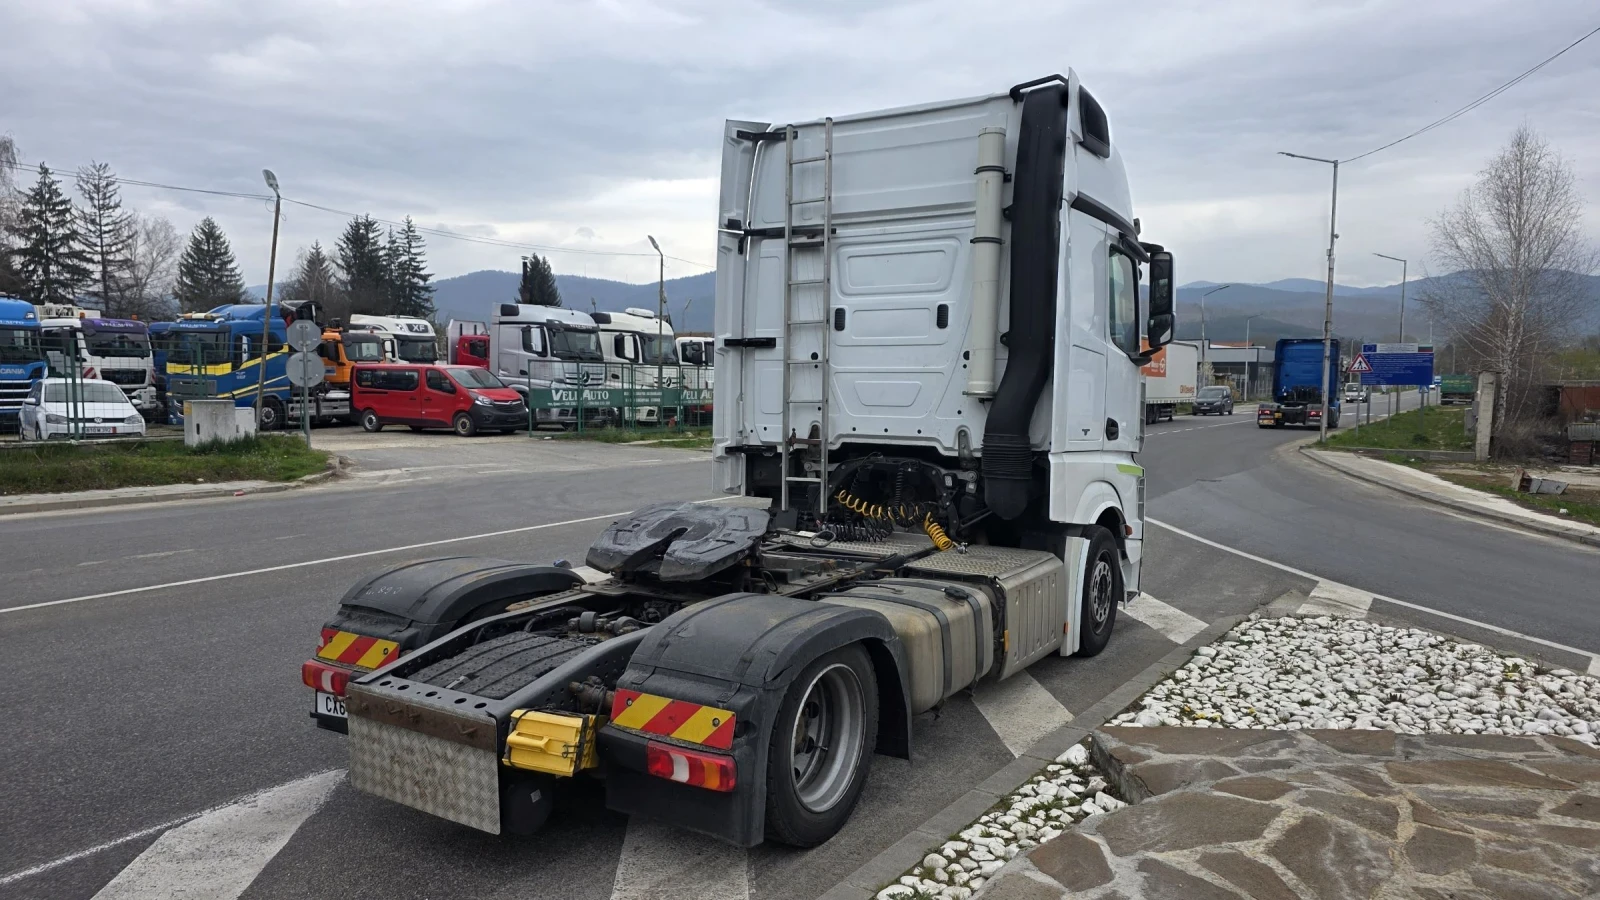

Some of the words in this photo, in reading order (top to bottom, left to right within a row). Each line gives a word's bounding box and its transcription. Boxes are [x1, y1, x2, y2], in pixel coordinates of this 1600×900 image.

[412, 324, 425, 332] XF
[551, 389, 578, 400] VELI
[582, 389, 609, 400] AUTO
[700, 390, 713, 400] AU
